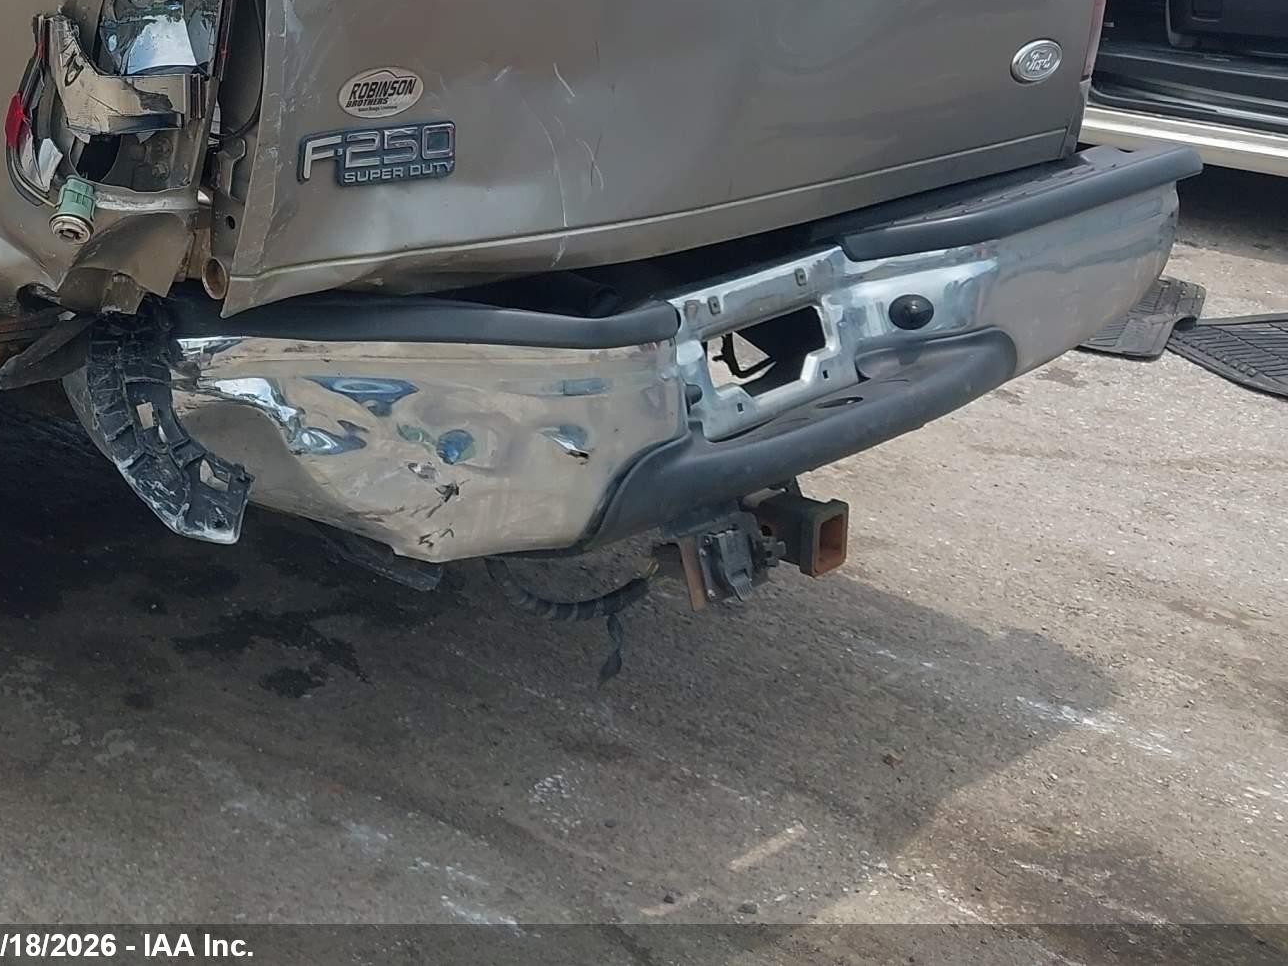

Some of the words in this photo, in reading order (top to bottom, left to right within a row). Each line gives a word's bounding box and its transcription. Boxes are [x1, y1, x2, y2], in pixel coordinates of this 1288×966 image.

[1025, 50, 1053, 71] Ford
[349, 79, 418, 100] ROBINSON
[344, 97, 390, 108] BROTHERS
[344, 167, 404, 183] SUPER
[409, 160, 455, 176] DUTY
